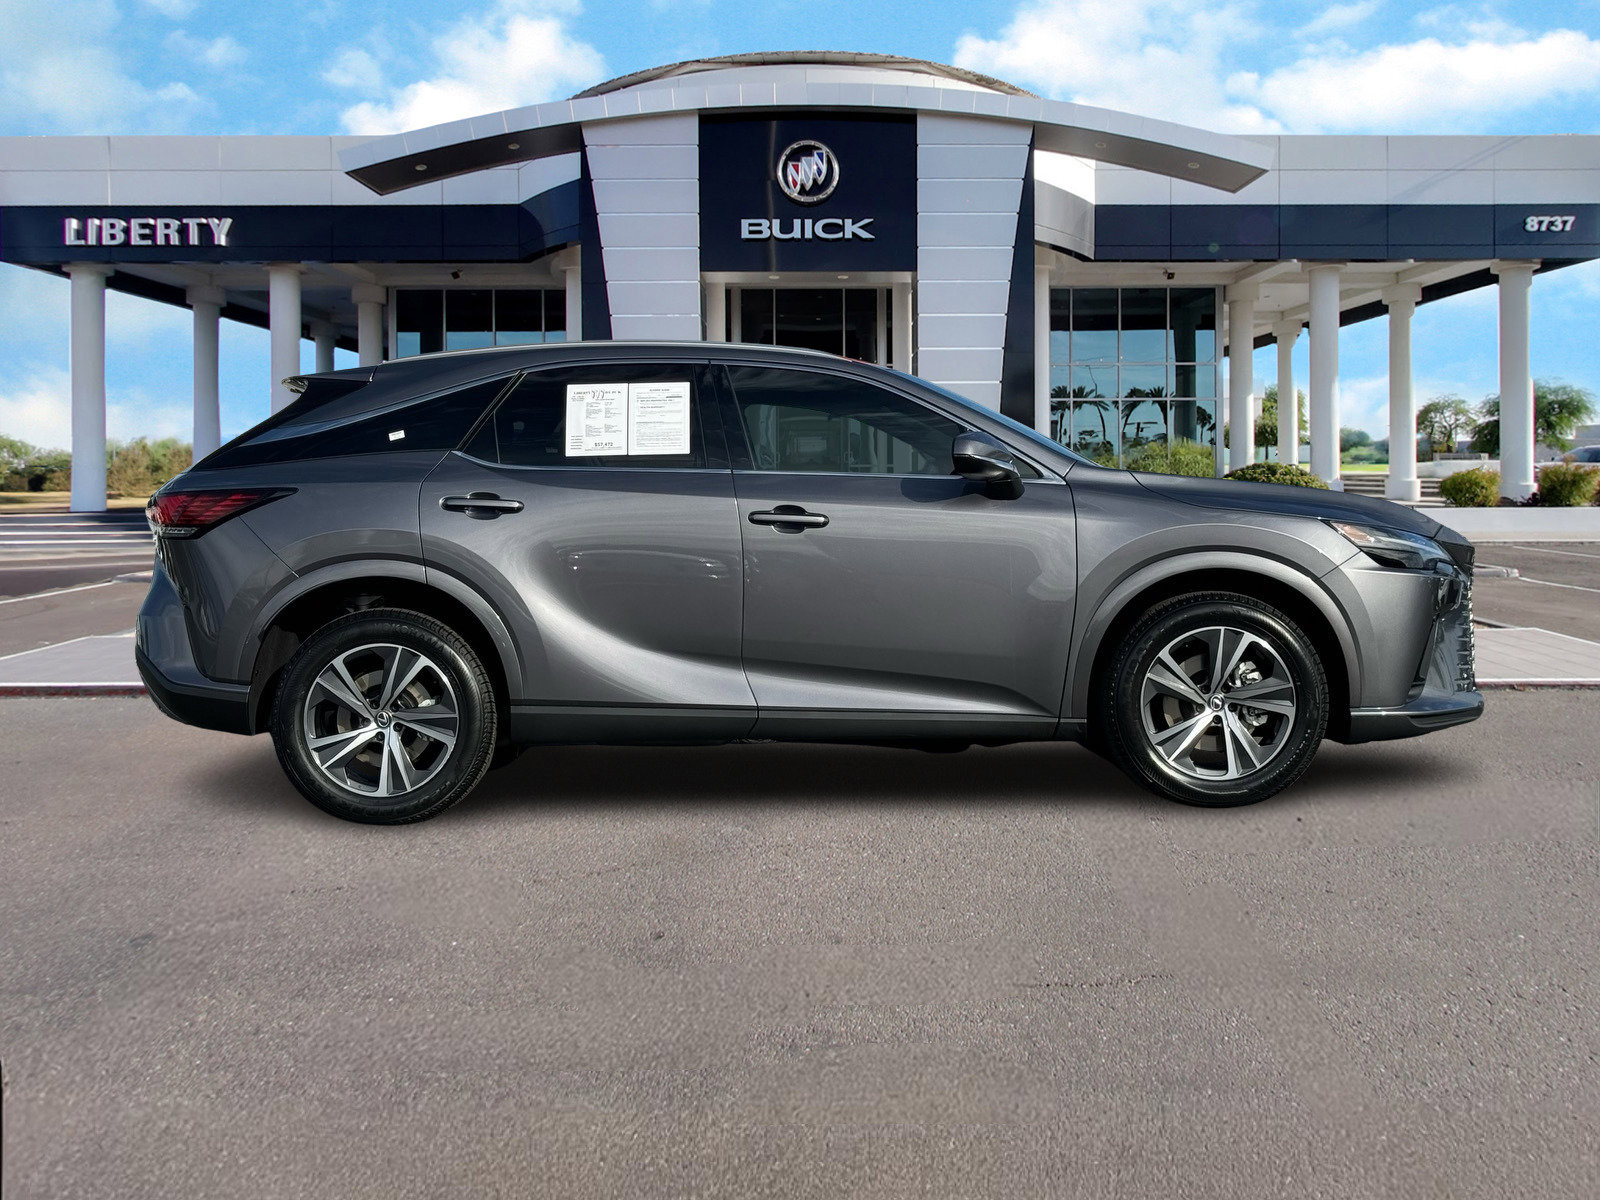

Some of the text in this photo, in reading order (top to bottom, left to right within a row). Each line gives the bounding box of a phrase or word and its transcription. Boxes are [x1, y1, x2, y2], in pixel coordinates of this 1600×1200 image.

[64, 217, 233, 246] LIBERTY
[740, 218, 876, 239] BUICK
[1524, 215, 1576, 231] 8737
